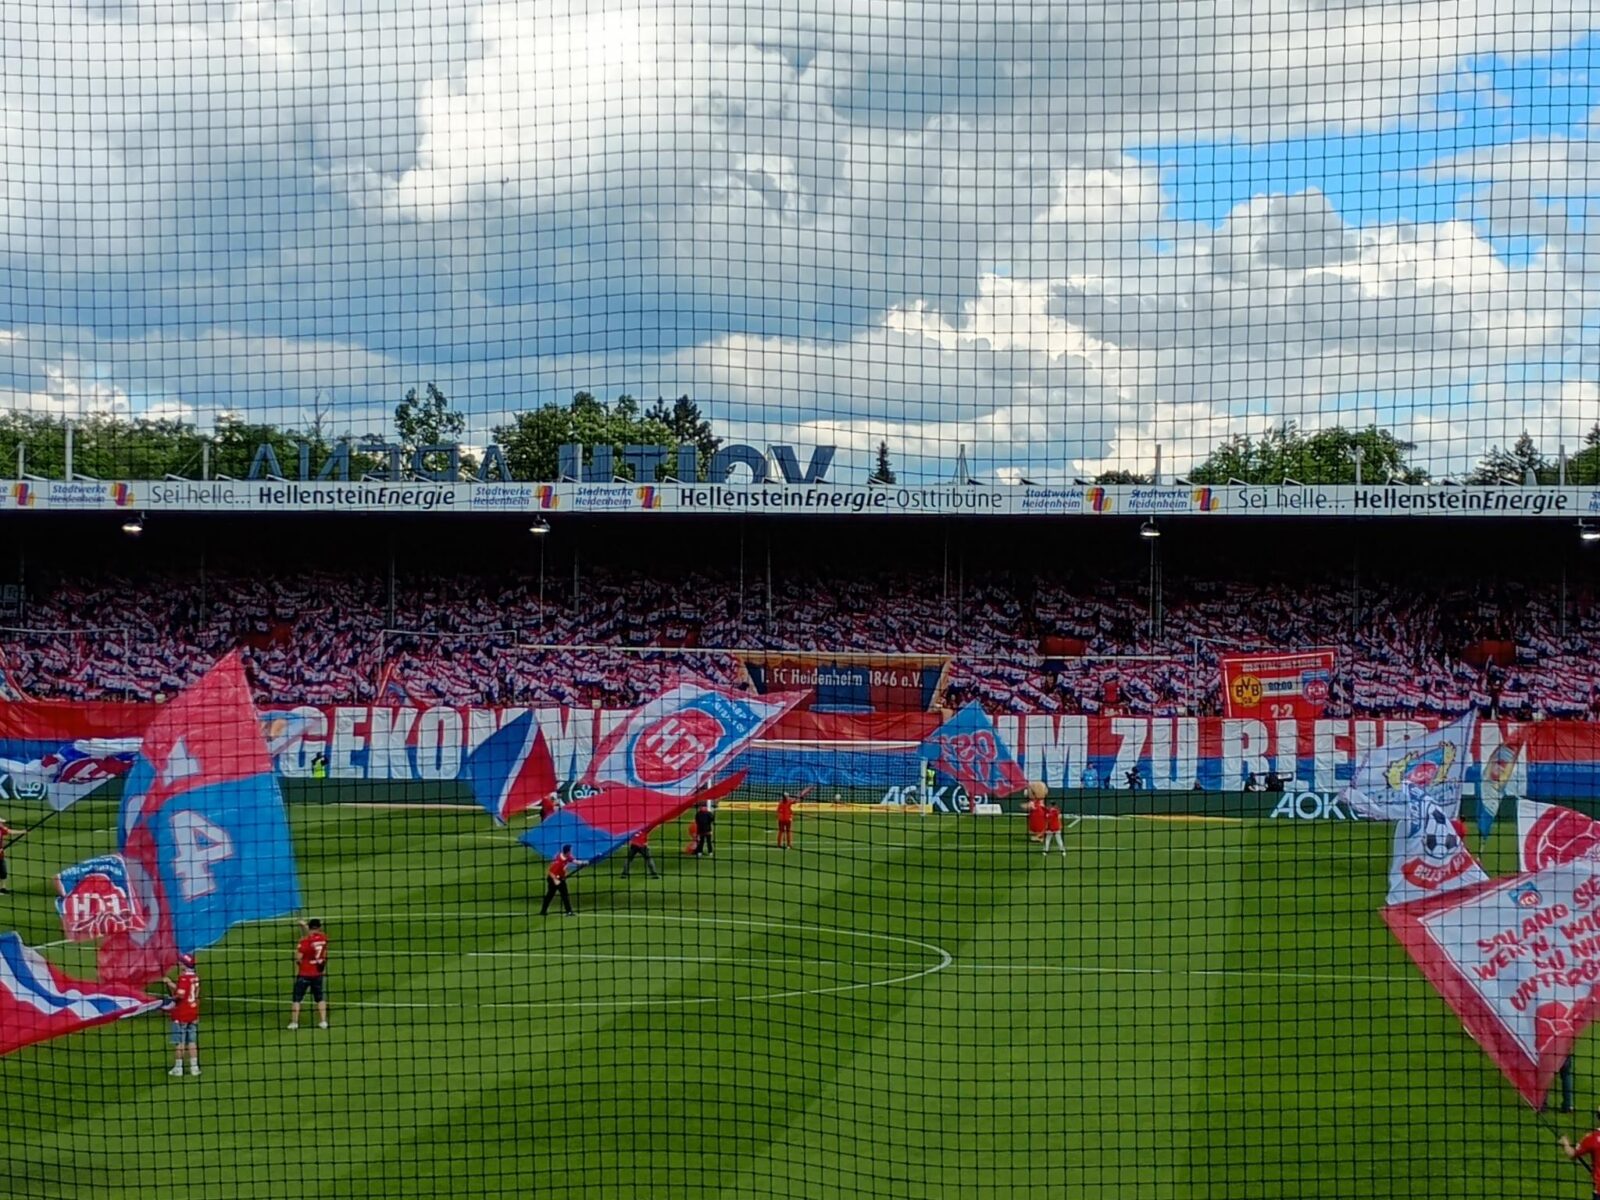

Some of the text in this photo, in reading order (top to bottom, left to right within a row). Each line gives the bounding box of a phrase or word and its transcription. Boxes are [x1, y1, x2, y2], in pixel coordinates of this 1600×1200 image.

[52, 484, 107, 494] Stadtwerke
[475, 486, 532, 496] Stadtwerke
[577, 486, 634, 496] Stadtwerke
[1025, 488, 1082, 499] Stadtwerke
[1131, 488, 1190, 499] Stadtwerke
[50, 495, 105, 503] Heidenheim
[152, 485, 251, 505] Sei helle...
[259, 485, 455, 509] HellensteinEnergie
[1239, 488, 1346, 509] Sei helle...
[473, 496, 530, 506] Heidenheim
[574, 497, 632, 507] Heidenheim
[1022, 499, 1081, 509] Heidenheim
[1128, 499, 1188, 509] Heidenheim
[1353, 489, 1567, 514] HellensteinEnergie
[774, 669, 787, 684] FC
[791, 669, 862, 686] Heidenheim
[869, 671, 897, 687] 1846
[1235, 678, 1260, 697] BVB
[1270, 791, 1346, 820] AOK
